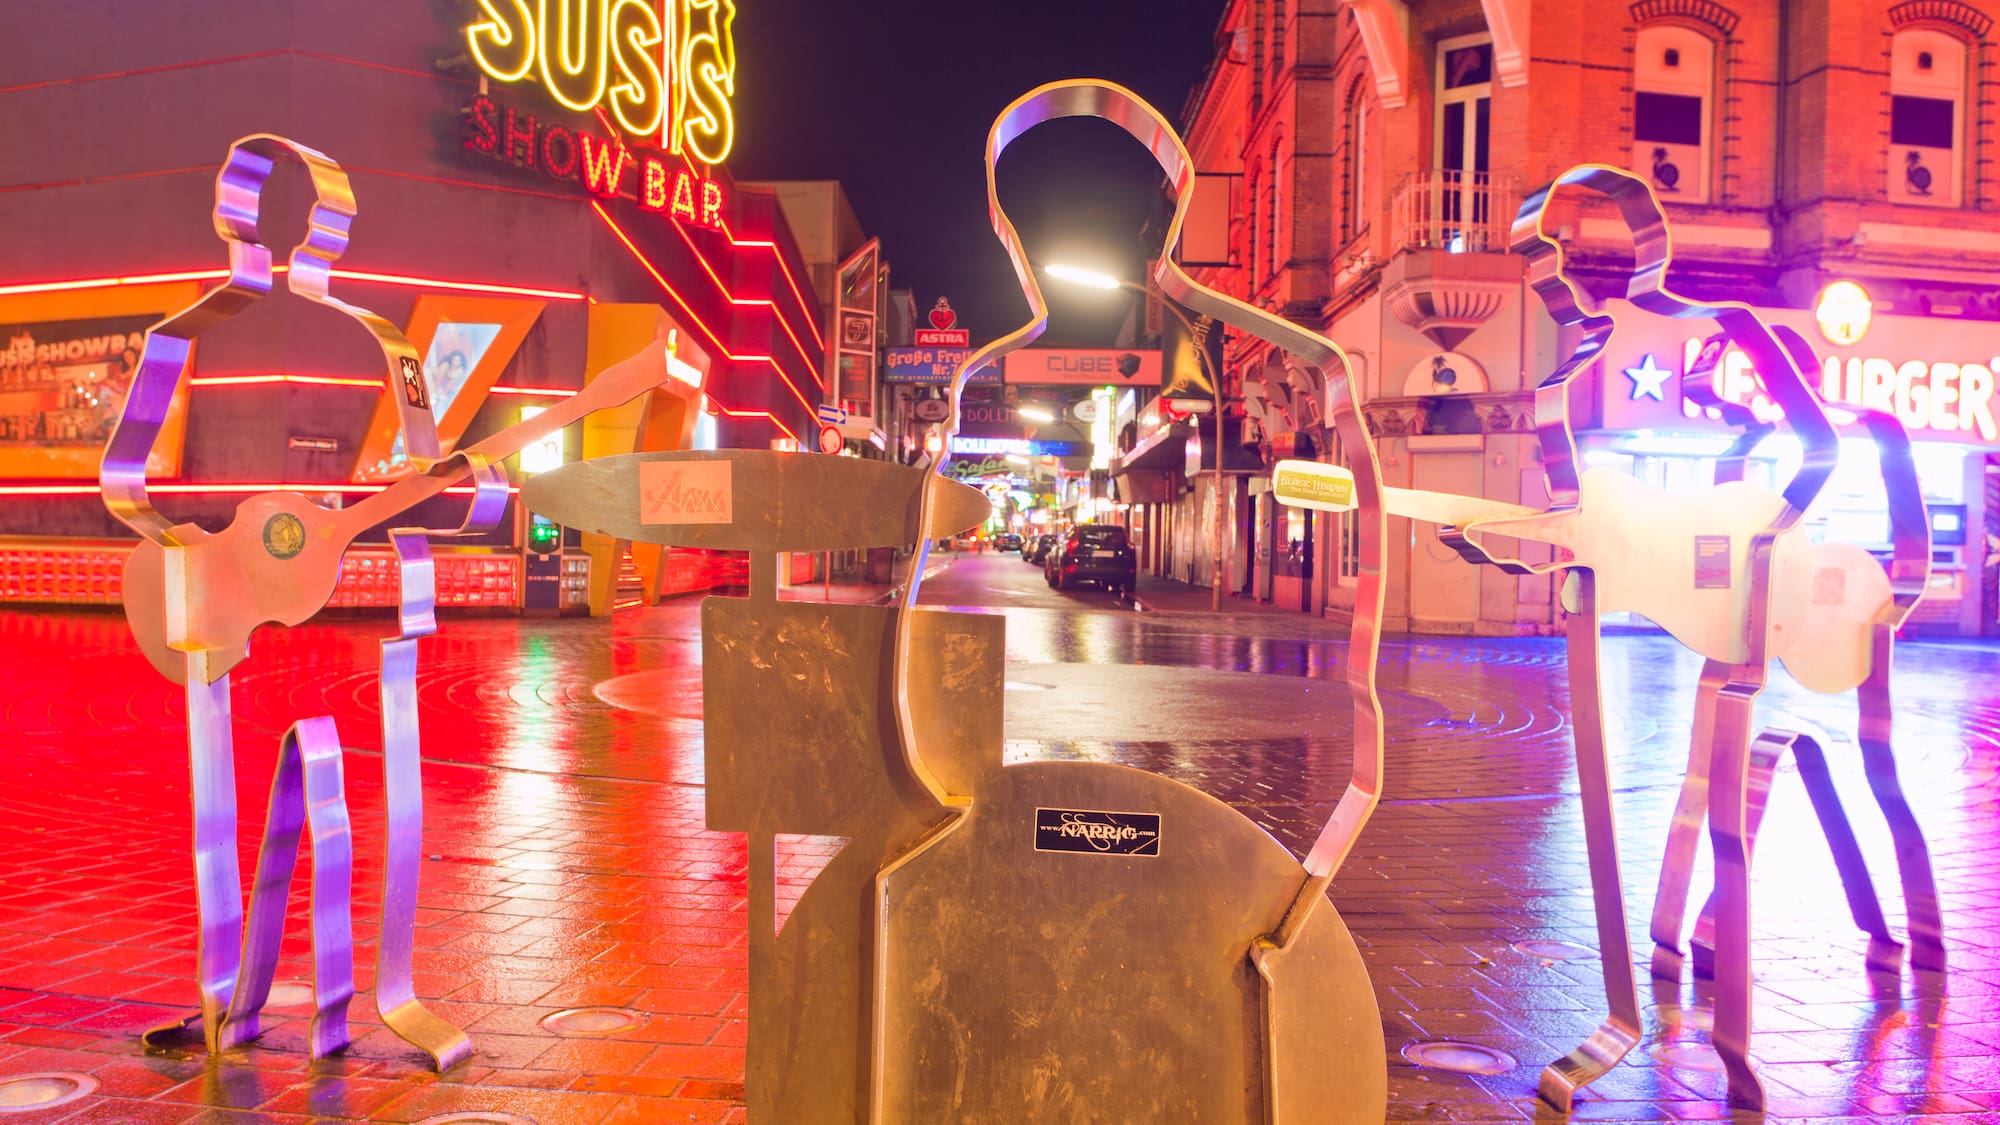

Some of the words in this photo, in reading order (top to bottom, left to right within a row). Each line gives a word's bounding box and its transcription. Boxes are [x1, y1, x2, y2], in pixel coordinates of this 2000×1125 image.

[470, 96, 627, 198] SHOW
[643, 158, 723, 230] BAR
[919, 333, 965, 344] ASTRA
[887, 350, 932, 368] Große
[1047, 355, 1112, 372] CUBE
